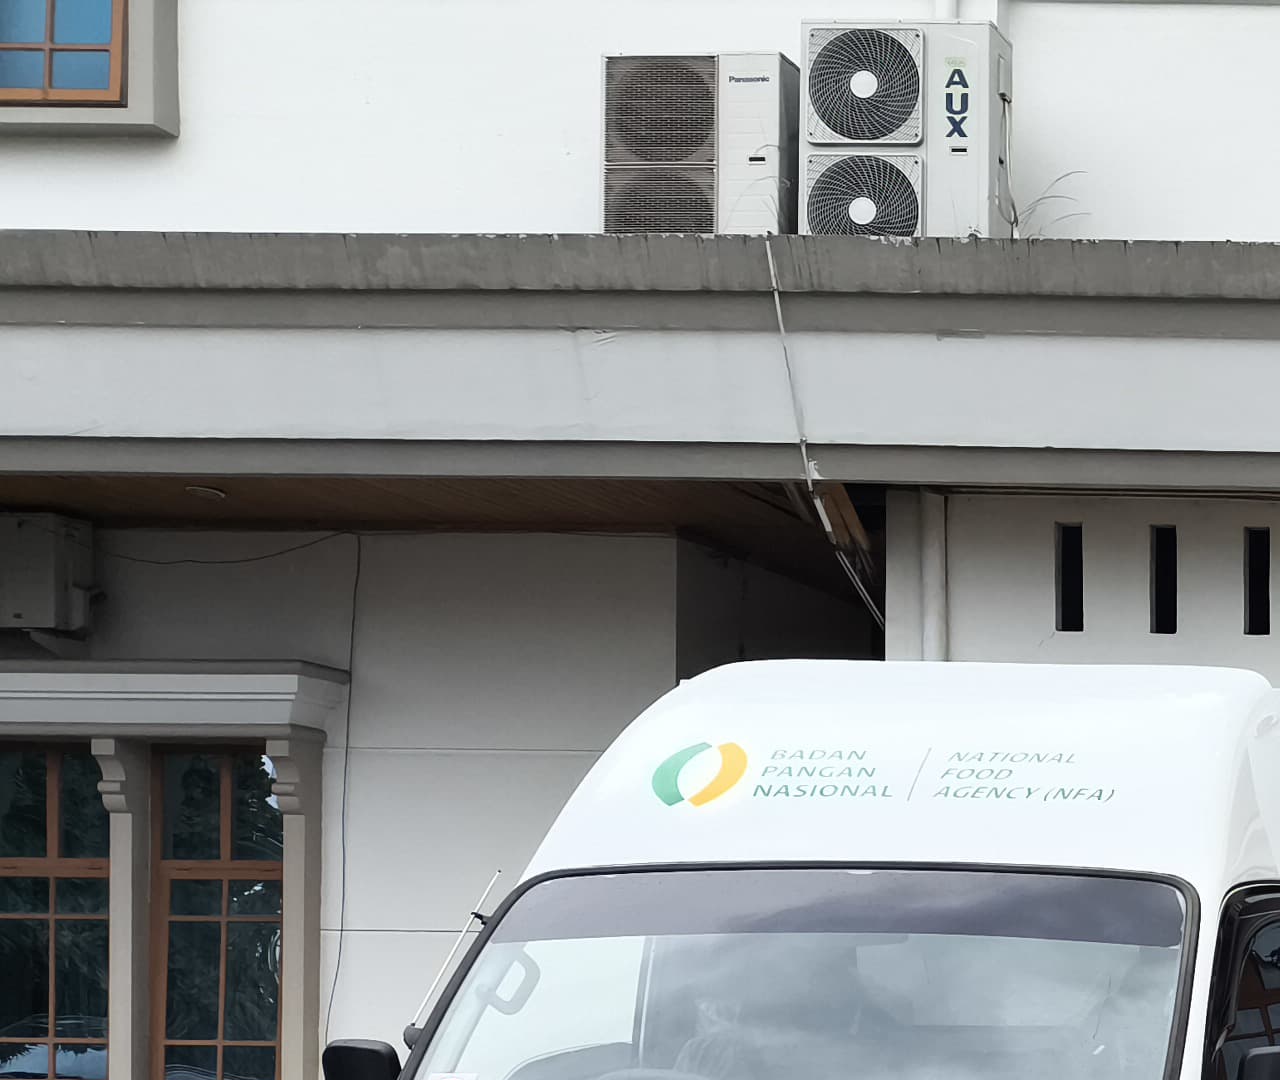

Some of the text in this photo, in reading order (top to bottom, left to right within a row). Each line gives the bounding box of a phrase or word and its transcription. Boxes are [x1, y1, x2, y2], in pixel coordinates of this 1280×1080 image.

[945, 68, 969, 137] AUX
[770, 749, 867, 761] BADAN
[948, 751, 1077, 765] NATIONAL
[761, 766, 877, 778] PANGAN
[940, 768, 1014, 780] FOOD
[752, 784, 895, 798] NASIONAL
[933, 786, 1116, 803] AGENCY (NFA)
